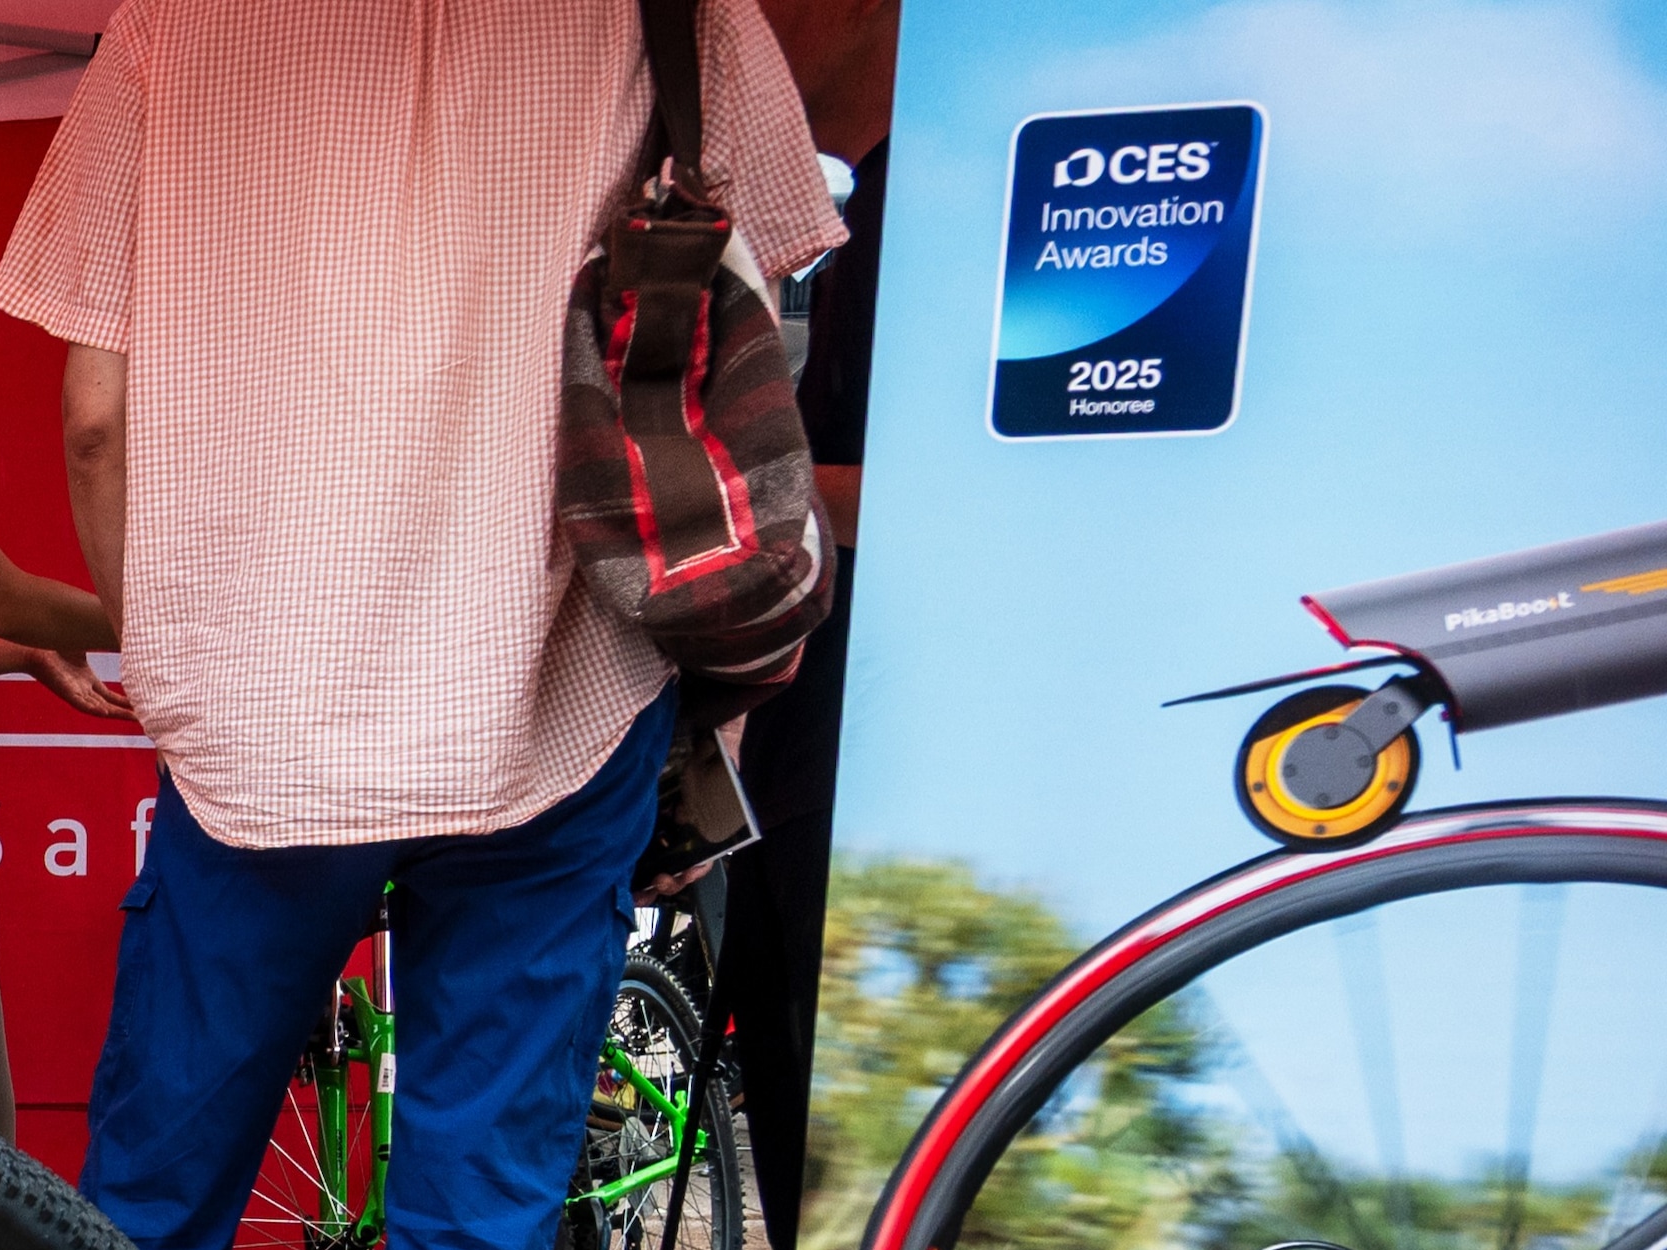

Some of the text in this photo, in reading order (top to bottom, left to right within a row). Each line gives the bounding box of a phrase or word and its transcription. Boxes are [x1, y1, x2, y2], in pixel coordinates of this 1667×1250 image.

[1041, 195, 1224, 232] Innovation
[1035, 237, 1169, 272] Awards
[1068, 358, 1162, 392] 2025
[1069, 396, 1155, 417] Honoree
[1445, 591, 1574, 631] PikaBoost
